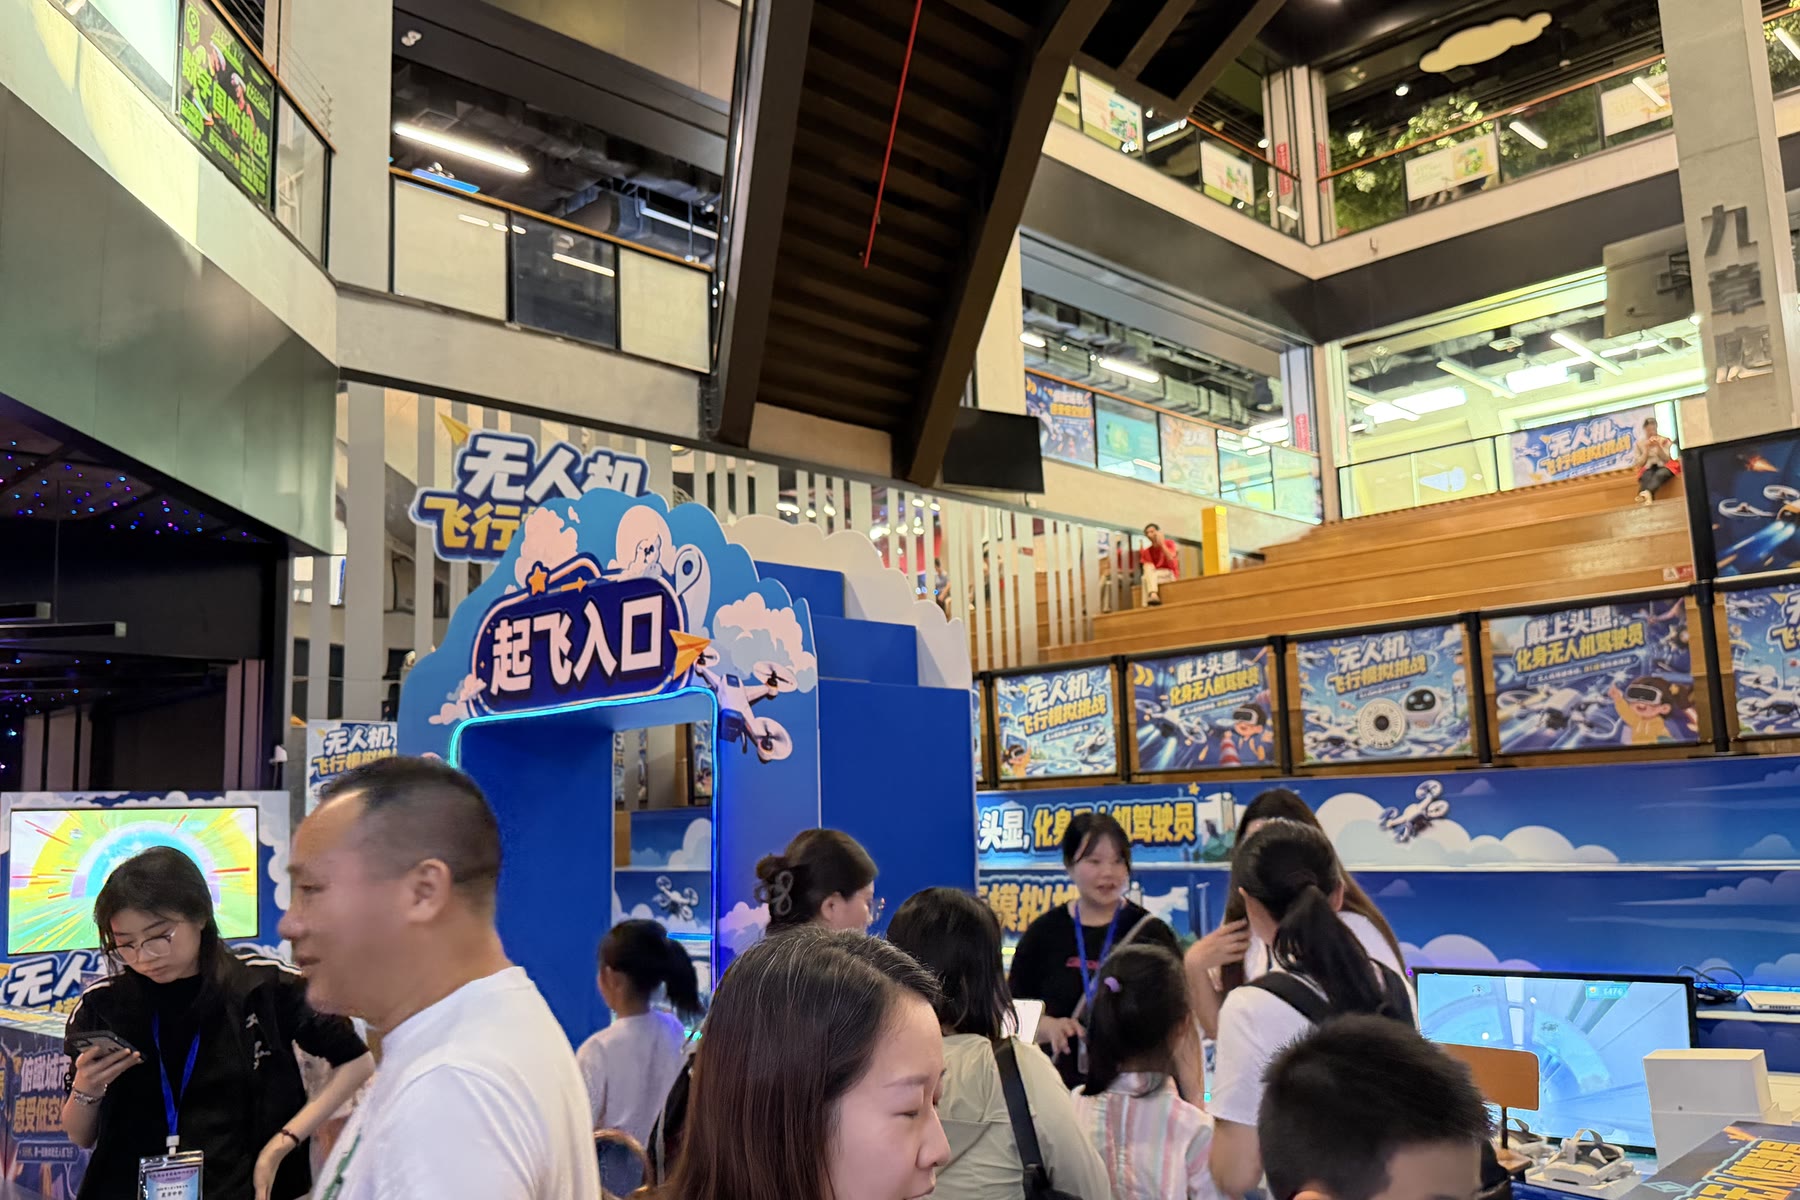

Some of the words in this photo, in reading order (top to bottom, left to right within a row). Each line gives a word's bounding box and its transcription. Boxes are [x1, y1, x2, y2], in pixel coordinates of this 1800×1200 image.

[463, 436, 642, 502] 无人机
[424, 496, 537, 550] 飞行
[490, 595, 662, 696] 起飞入口
[1338, 634, 1410, 673] 无人机
[1515, 622, 1644, 672] 化身无人机驾驶员
[1027, 672, 1092, 713] 无人机
[1329, 655, 1427, 694] 飞行模拟挑战
[324, 726, 393, 756] 无人机
[14, 1096, 67, 1133] 感受低空
